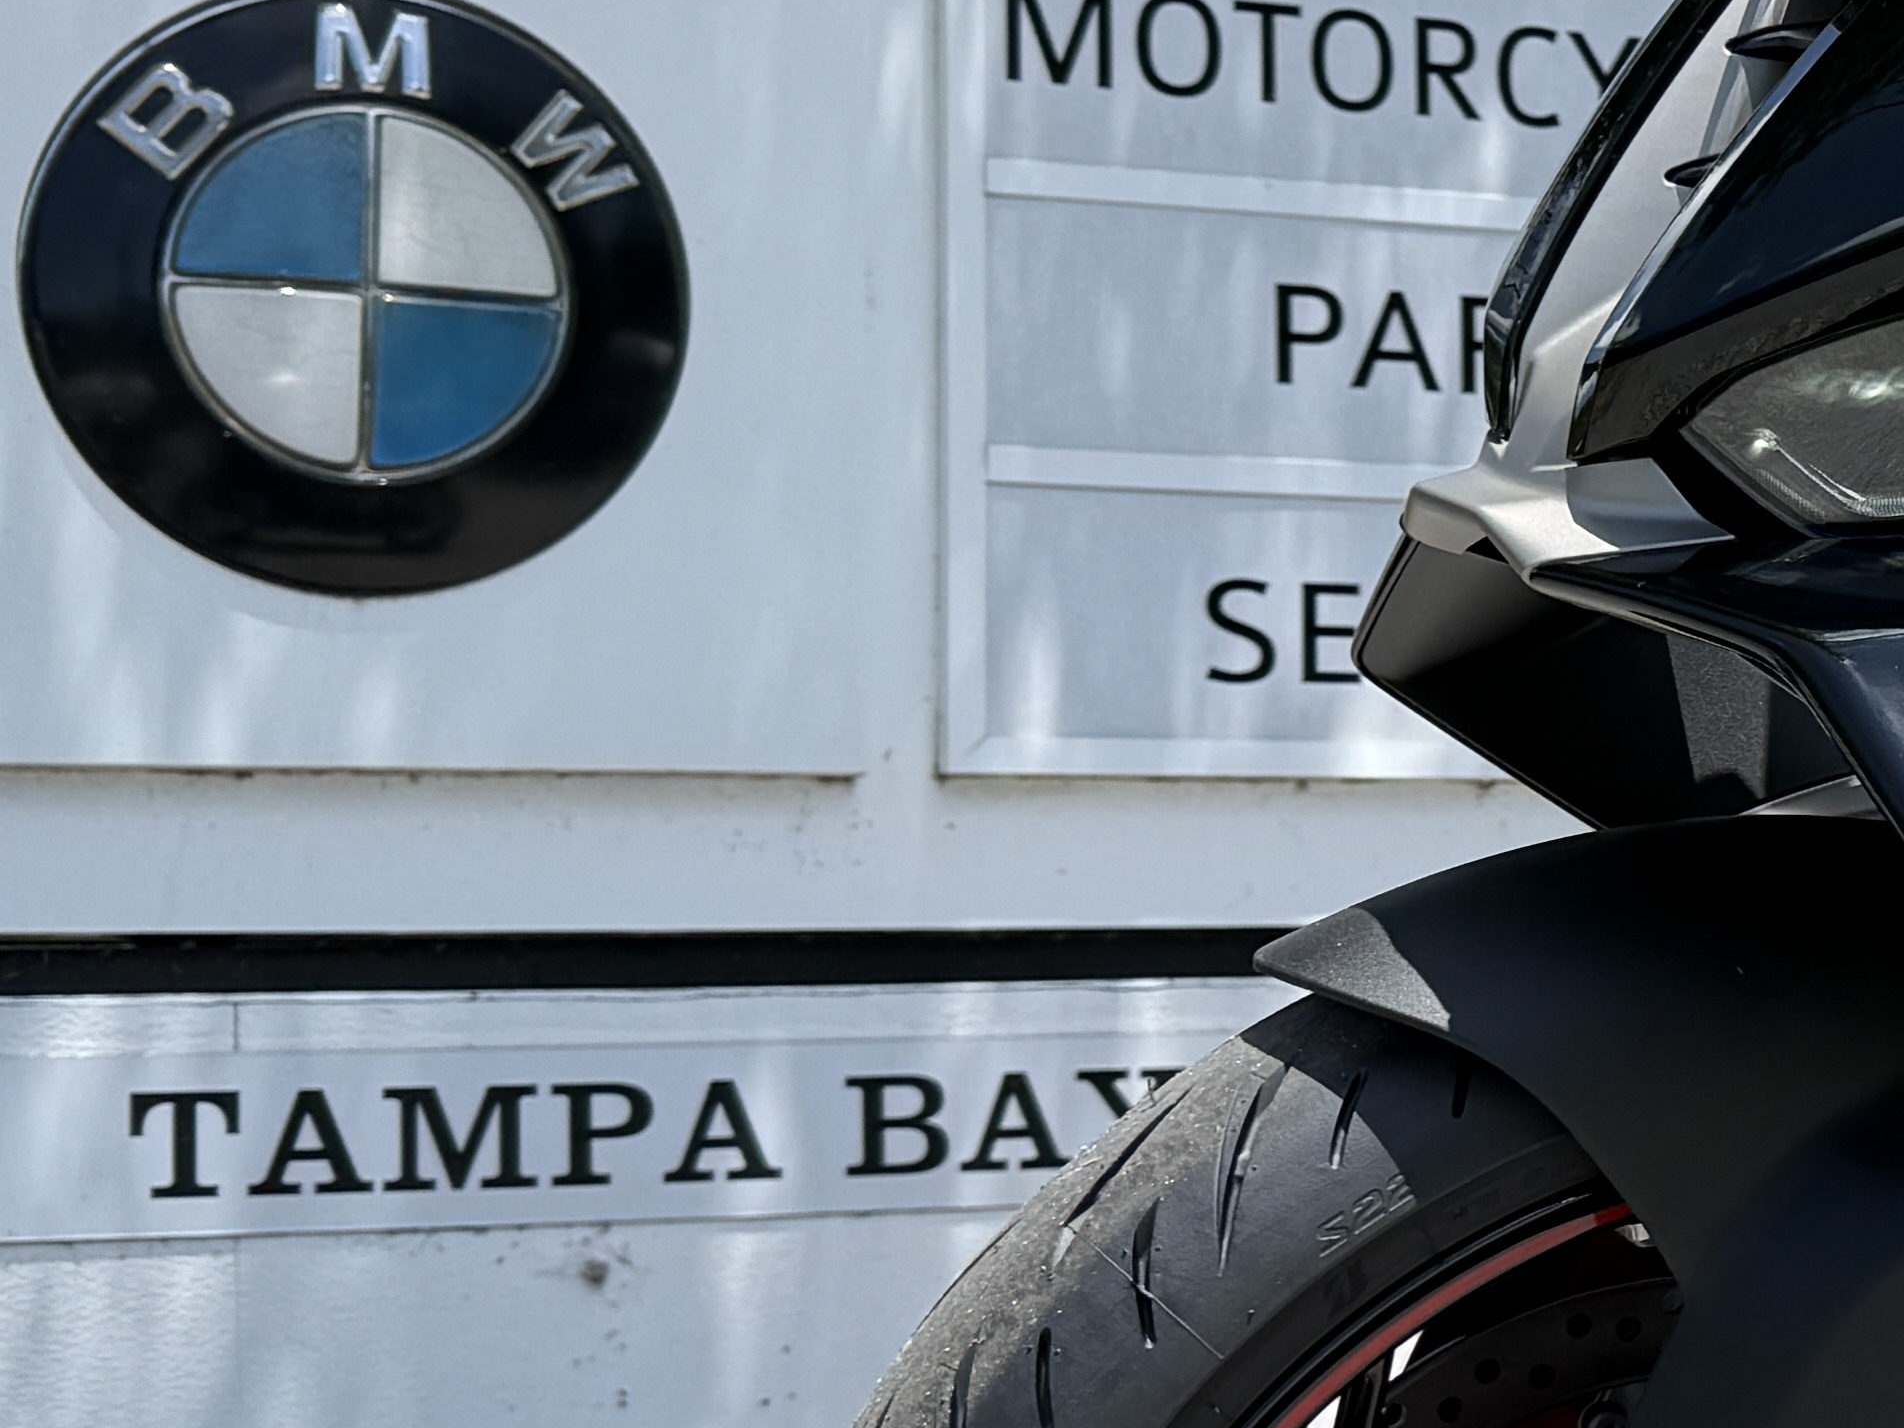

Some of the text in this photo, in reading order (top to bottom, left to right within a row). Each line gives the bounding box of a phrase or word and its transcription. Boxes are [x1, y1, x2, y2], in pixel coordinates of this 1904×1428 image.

[97, 2, 640, 213] BMW
[1205, 577, 1363, 685] SE
[129, 1079, 783, 1199] TAMPA
[1315, 1172, 1416, 1258] S22
